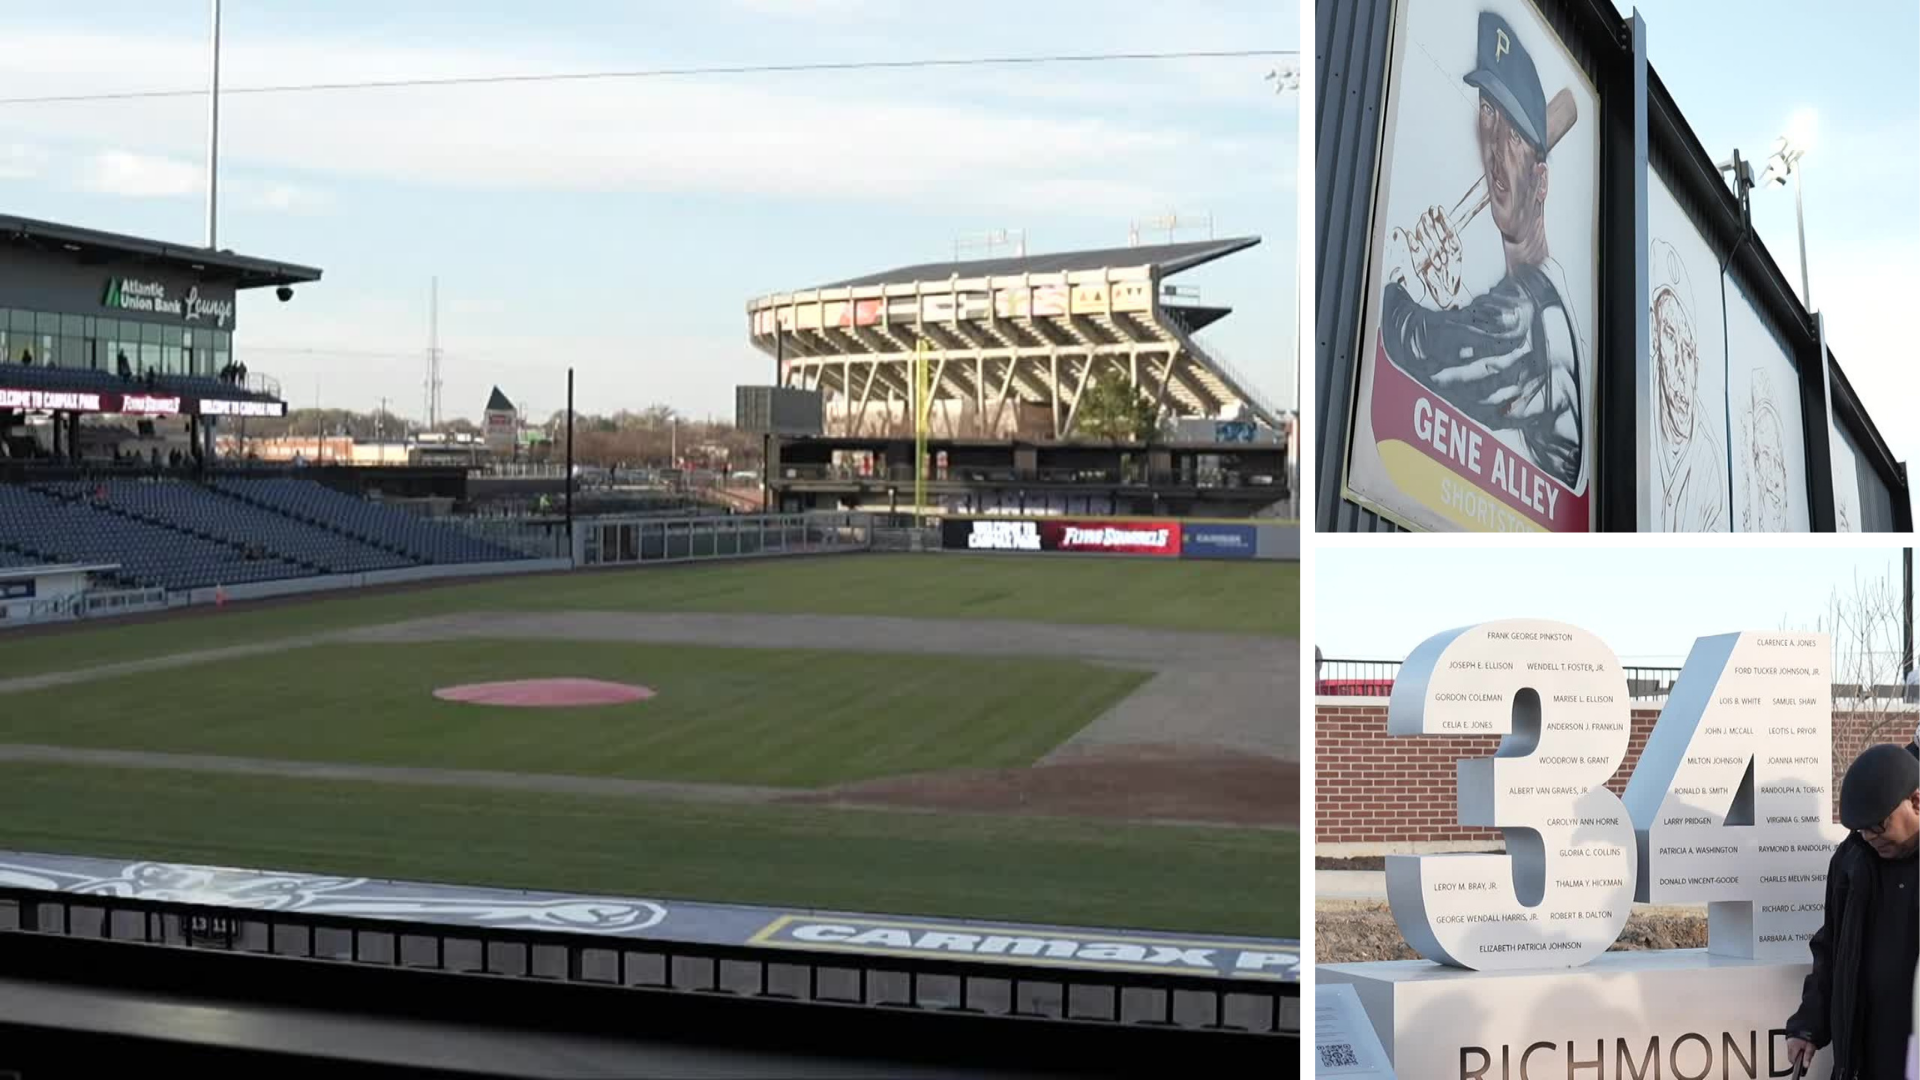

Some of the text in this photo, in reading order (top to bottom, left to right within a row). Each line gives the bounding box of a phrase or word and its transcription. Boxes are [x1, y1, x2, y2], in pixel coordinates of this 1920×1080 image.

[121, 279, 164, 296] Atlantic
[120, 296, 181, 313] Union Bank
[185, 286, 232, 327] Lounge
[1414, 397, 1559, 521] GENE ALLEY
[1511, 632, 1538, 640] GEORGE
[1539, 633, 1572, 641] PINKSTON
[1797, 639, 1816, 647] JONES
[1449, 661, 1476, 669] JOSEPH
[1485, 662, 1513, 670] ELLISON
[1527, 662, 1559, 671] WENDELL
[1561, 663, 1566, 671] T.
[1567, 663, 1594, 672] FOSTER,
[1753, 667, 1777, 675] TUCKER
[1779, 667, 1811, 676] JOHNSON,
[1812, 668, 1820, 676] JR.
[1435, 693, 1502, 701] GORDON COLEMAN
[1719, 697, 1733, 705] LOIS
[1734, 697, 1740, 705] B.
[1442, 721, 1493, 729] CELIA E. JONES
[1585, 722, 1590, 731] J.
[1592, 723, 1623, 731] FRANKLIN
[1705, 727, 1754, 735] JOHN J. MCCALL
[1768, 727, 1789, 735] LEOTIS
[1797, 727, 1817, 735] PRYOR
[1539, 756, 1578, 764] WOODROW
[1713, 757, 1743, 765] JOHNSON
[1509, 787, 1589, 795] ALBERT VAN GRAVES, JR.
[1674, 787, 1701, 795] RONALD
[1761, 786, 1794, 794] RANDOLPH
[1802, 786, 1824, 794] TOBIAS
[1547, 818, 1578, 826] CAROLYN
[1595, 818, 1619, 826] HORNE
[1664, 817, 1711, 826] LARRY PRIDGEN
[1766, 816, 1792, 824] VIRGINIA
[1660, 847, 1687, 855] PATRICIA
[1695, 846, 1738, 854] WASHINGTON
[1797, 844, 1832, 852] RANDOLPH,
[1559, 848, 1621, 857] GLORIA C. COLLINS
[1688, 876, 1738, 884] VINCENT-GOODE
[1788, 874, 1810, 882] MELVIN
[1434, 883, 1456, 891] LEROY
[1468, 882, 1487, 891] BRAY,
[1488, 882, 1497, 890] JR.
[1592, 879, 1623, 887] HICKMAN
[1790, 904, 1796, 912] C.
[1436, 913, 1539, 924] GEORGE WENDALL HARRIS, JR.
[1550, 912, 1576, 920] ROBERT
[1585, 910, 1612, 919] DALTON
[1759, 934, 1787, 943] BARBARA
[1479, 941, 1581, 953] ELIZABETH PATRICIA JOHNSON
